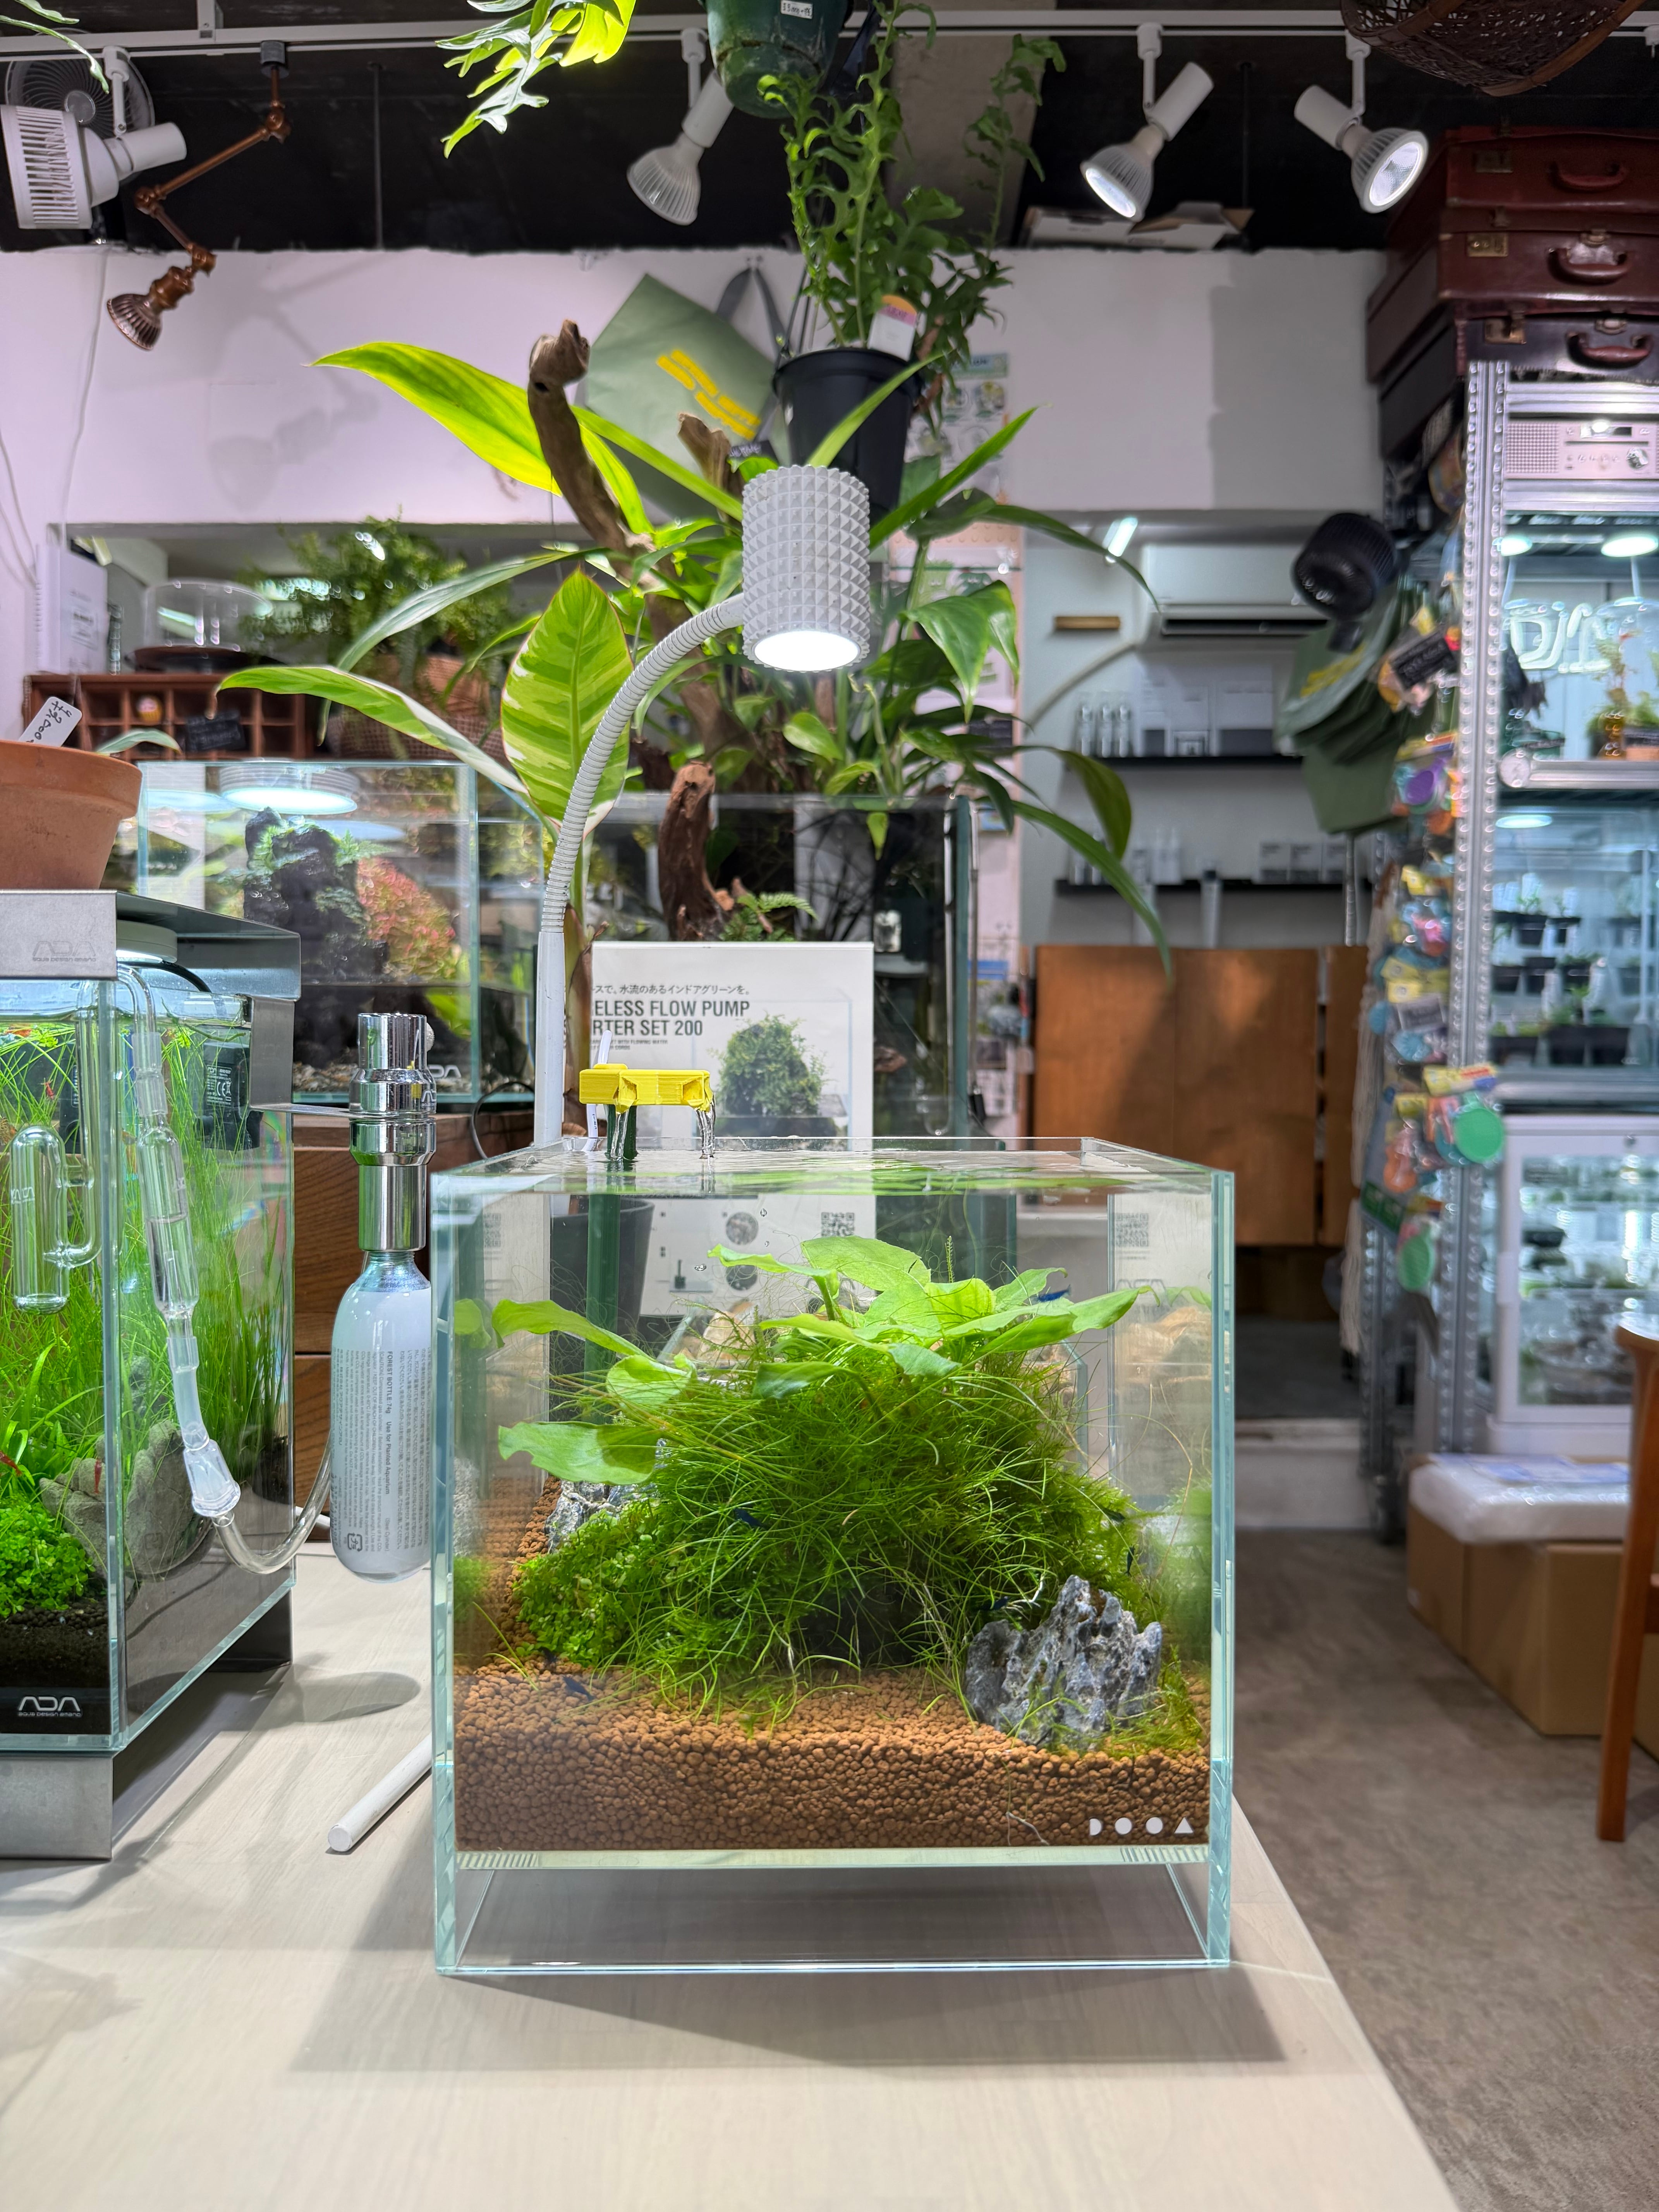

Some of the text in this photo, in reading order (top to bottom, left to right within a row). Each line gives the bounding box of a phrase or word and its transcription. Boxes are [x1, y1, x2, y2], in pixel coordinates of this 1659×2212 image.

[33, 941, 96, 957] ADA
[592, 1000, 750, 1017] ELESS FLOW PUMP
[641, 1020, 670, 1036] SET
[675, 1020, 702, 1036] 200
[427, 1065, 461, 1078] DA
[351, 1538, 359, 1549] プラ
[19, 1697, 81, 1711] ADA
